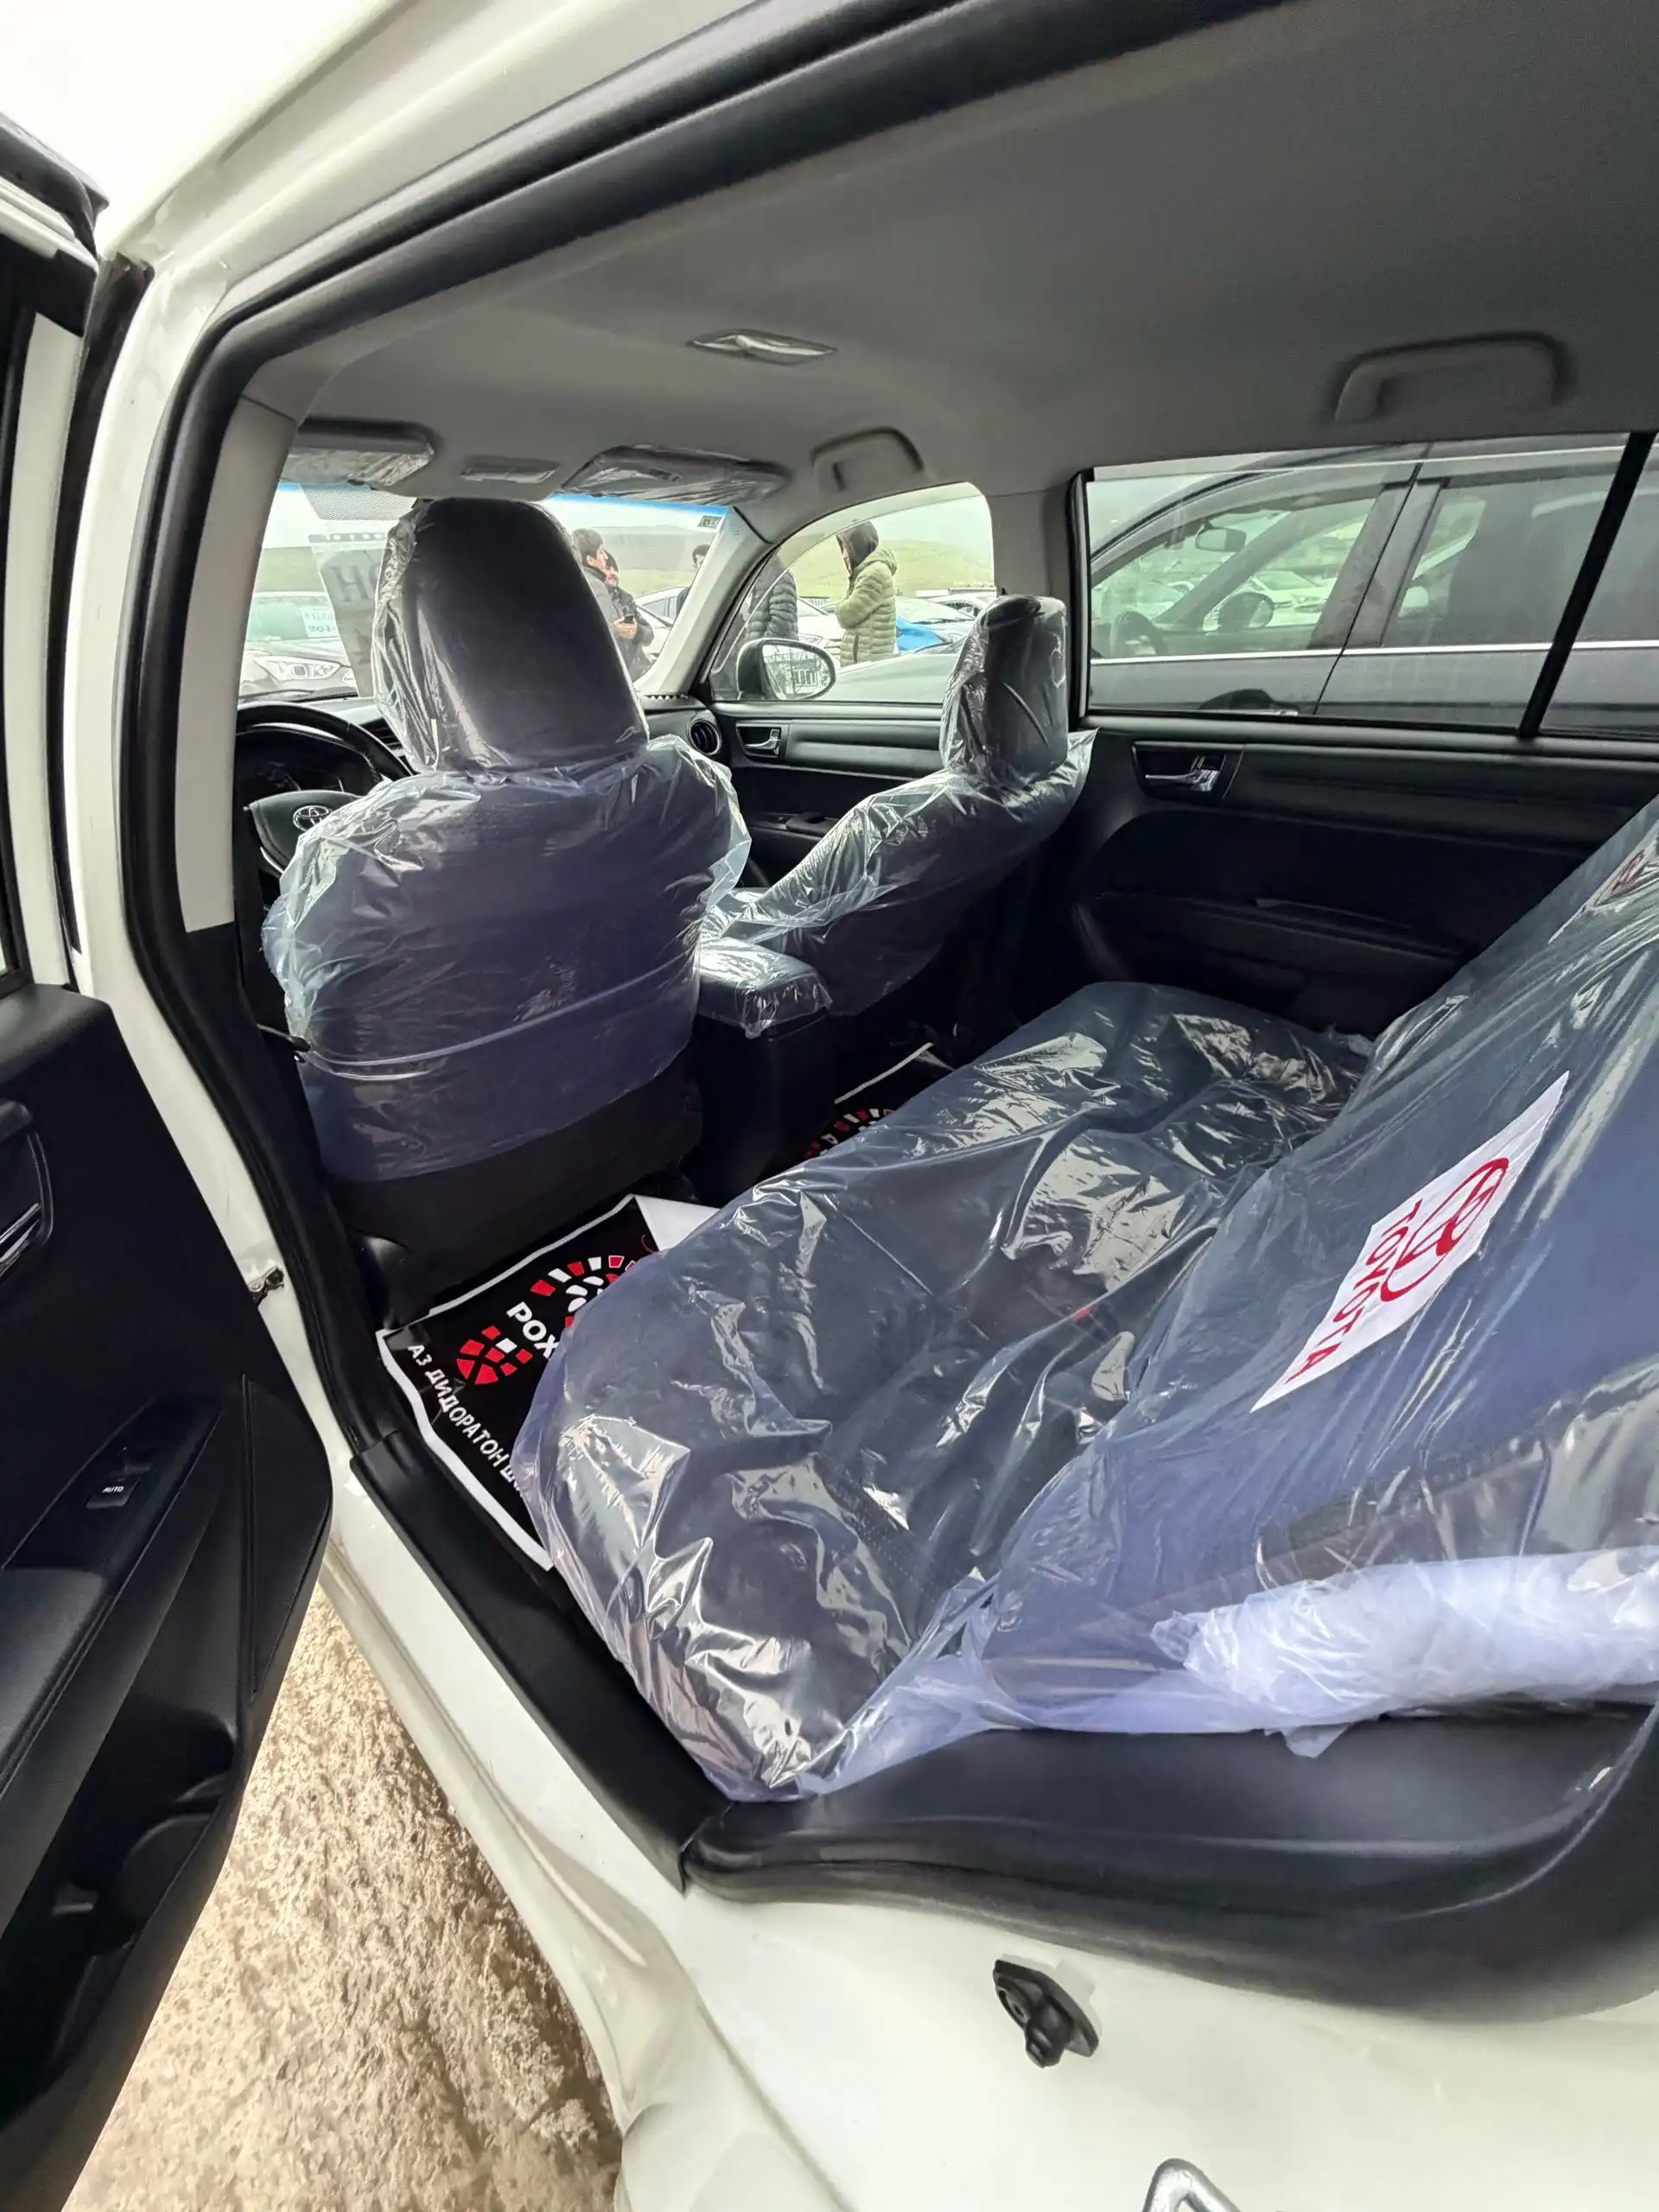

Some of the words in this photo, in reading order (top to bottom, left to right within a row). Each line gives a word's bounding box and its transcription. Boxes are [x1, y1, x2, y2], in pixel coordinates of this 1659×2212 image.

[1284, 1198, 1423, 1385] TOYOTA
[424, 1369, 510, 1467] ДИДОРАТОН
[102, 1485, 124, 1494] AUTO
